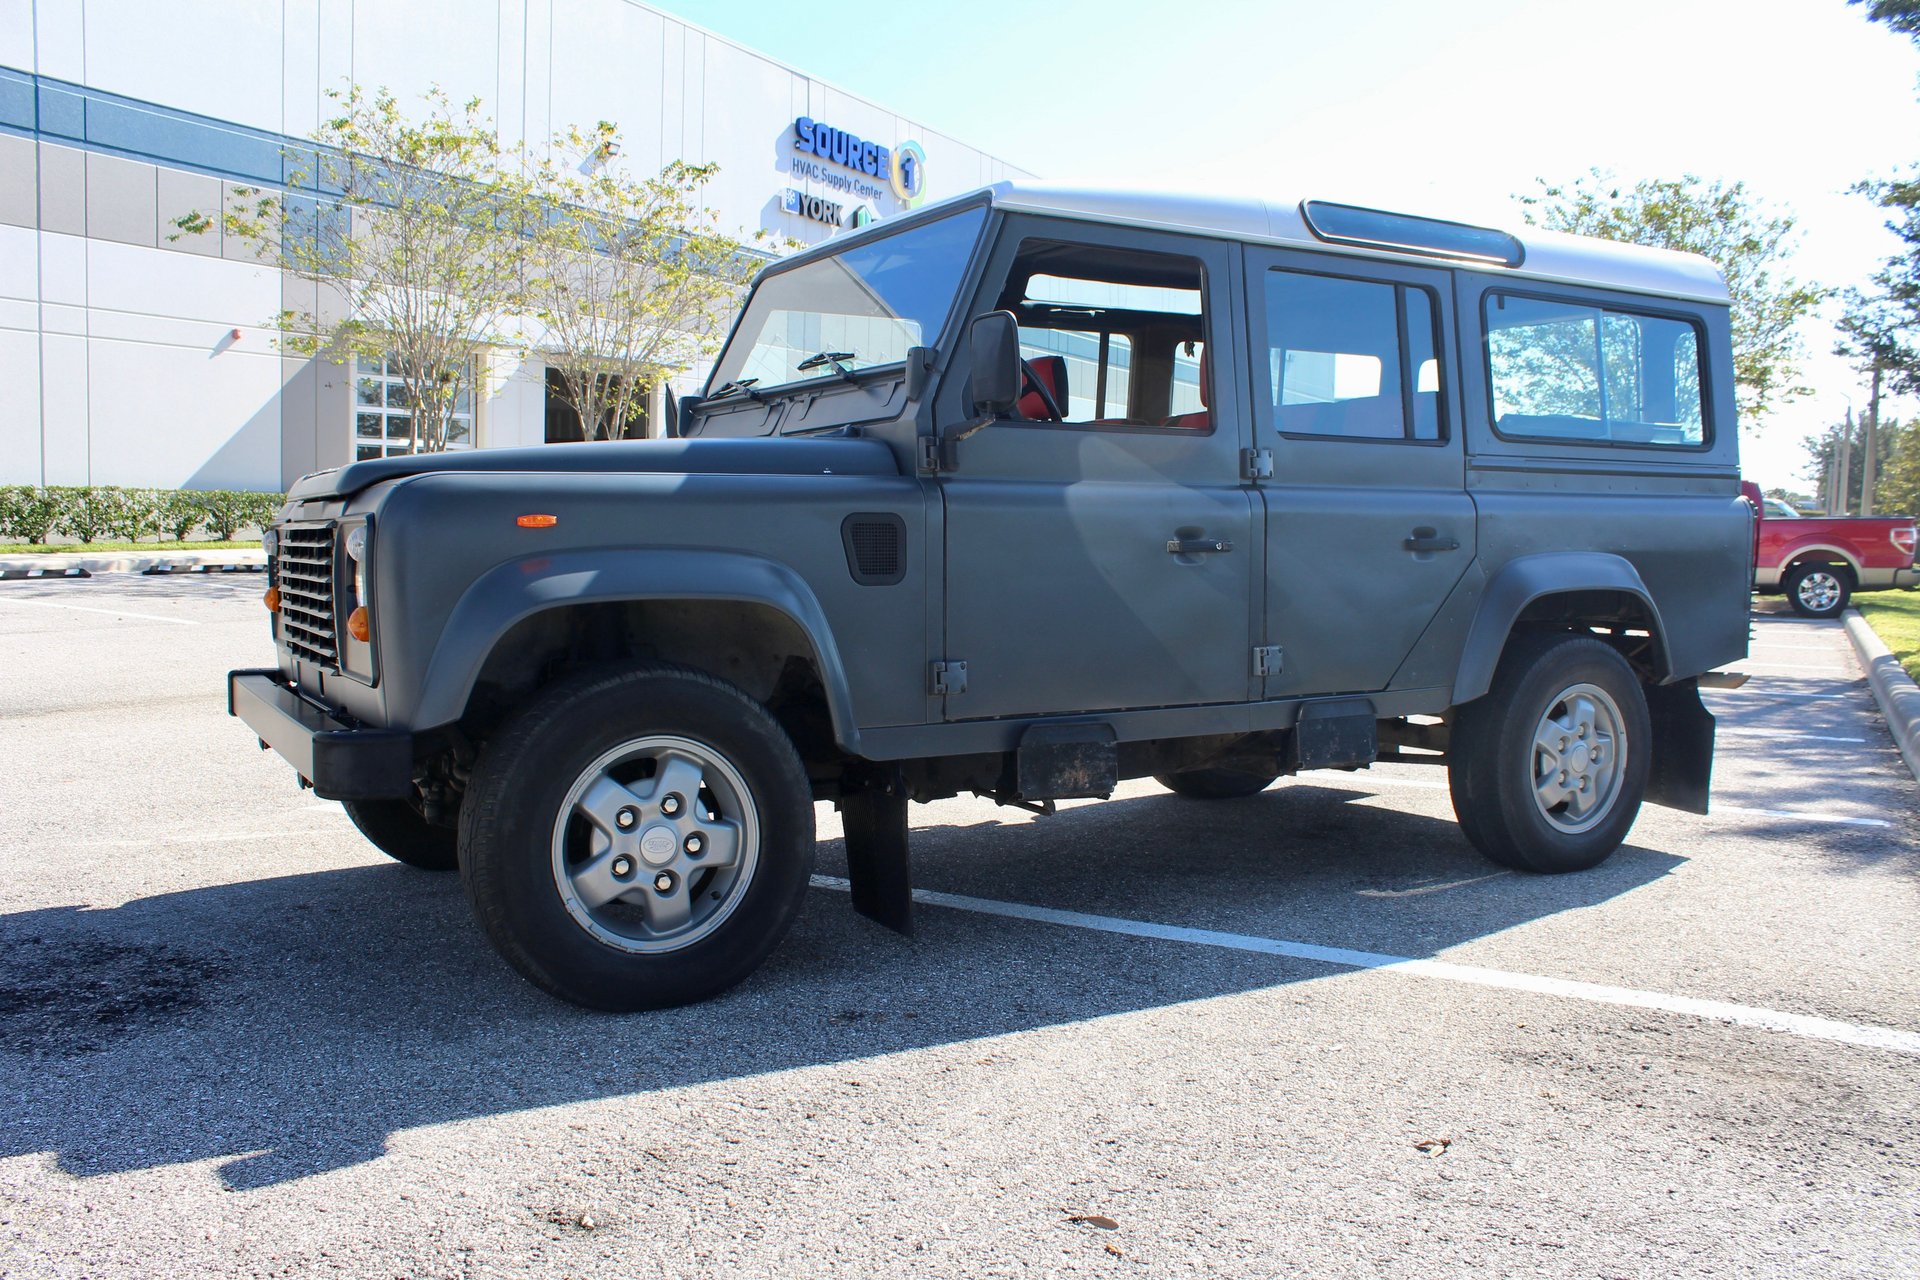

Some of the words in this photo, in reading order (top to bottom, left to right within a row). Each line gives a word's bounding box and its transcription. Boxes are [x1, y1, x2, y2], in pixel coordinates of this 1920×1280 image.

[795, 117, 890, 180] SOURCE
[901, 157, 916, 190] 1
[792, 157, 819, 179] HVAC
[821, 170, 852, 192] Supply
[853, 180, 883, 201] Center
[799, 192, 844, 227] YORK
